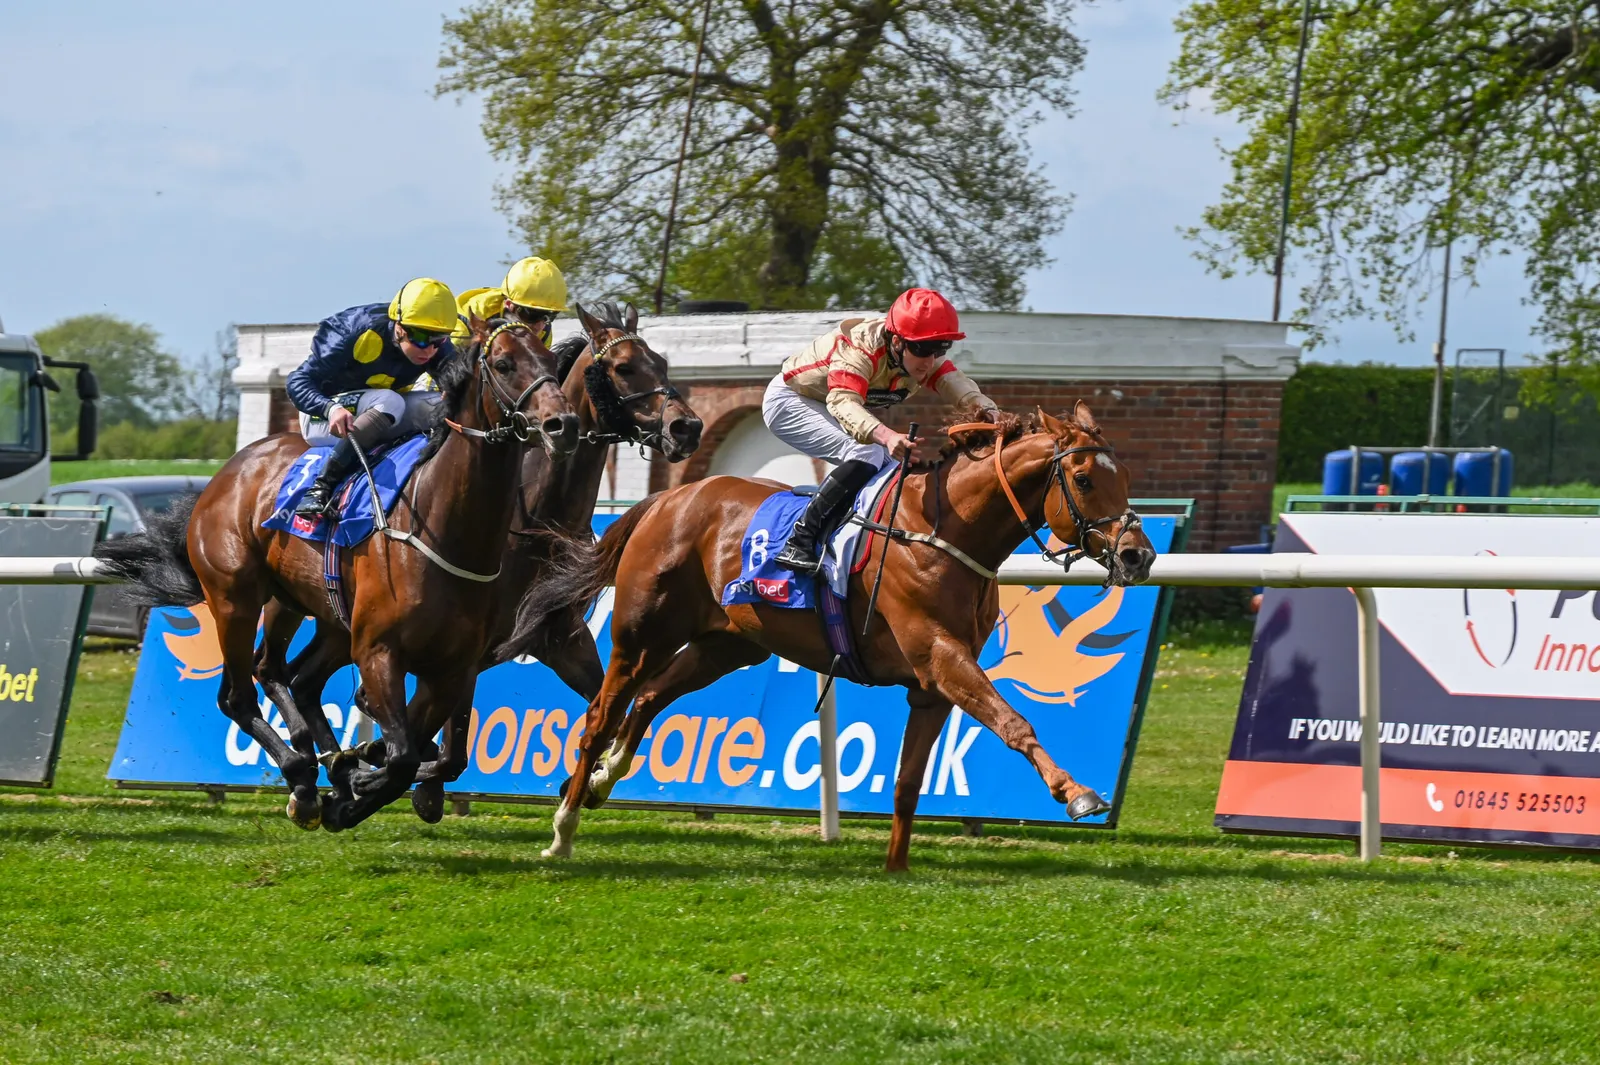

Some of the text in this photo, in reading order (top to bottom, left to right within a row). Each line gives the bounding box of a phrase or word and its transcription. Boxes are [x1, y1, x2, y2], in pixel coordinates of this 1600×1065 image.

[287, 454, 322, 497] 3
[748, 529, 769, 572] 8
[757, 580, 785, 597] bet
[1288, 718, 1306, 740] IF
[1307, 719, 1345, 741] YOU
[1345, 720, 1410, 744] WULD
[1410, 723, 1451, 747] LIKE
[1451, 725, 1477, 748] TO
[1476, 726, 1537, 750] LEARN
[1535, 728, 1592, 753] MORE
[1454, 789, 1587, 814] 01845 525503
